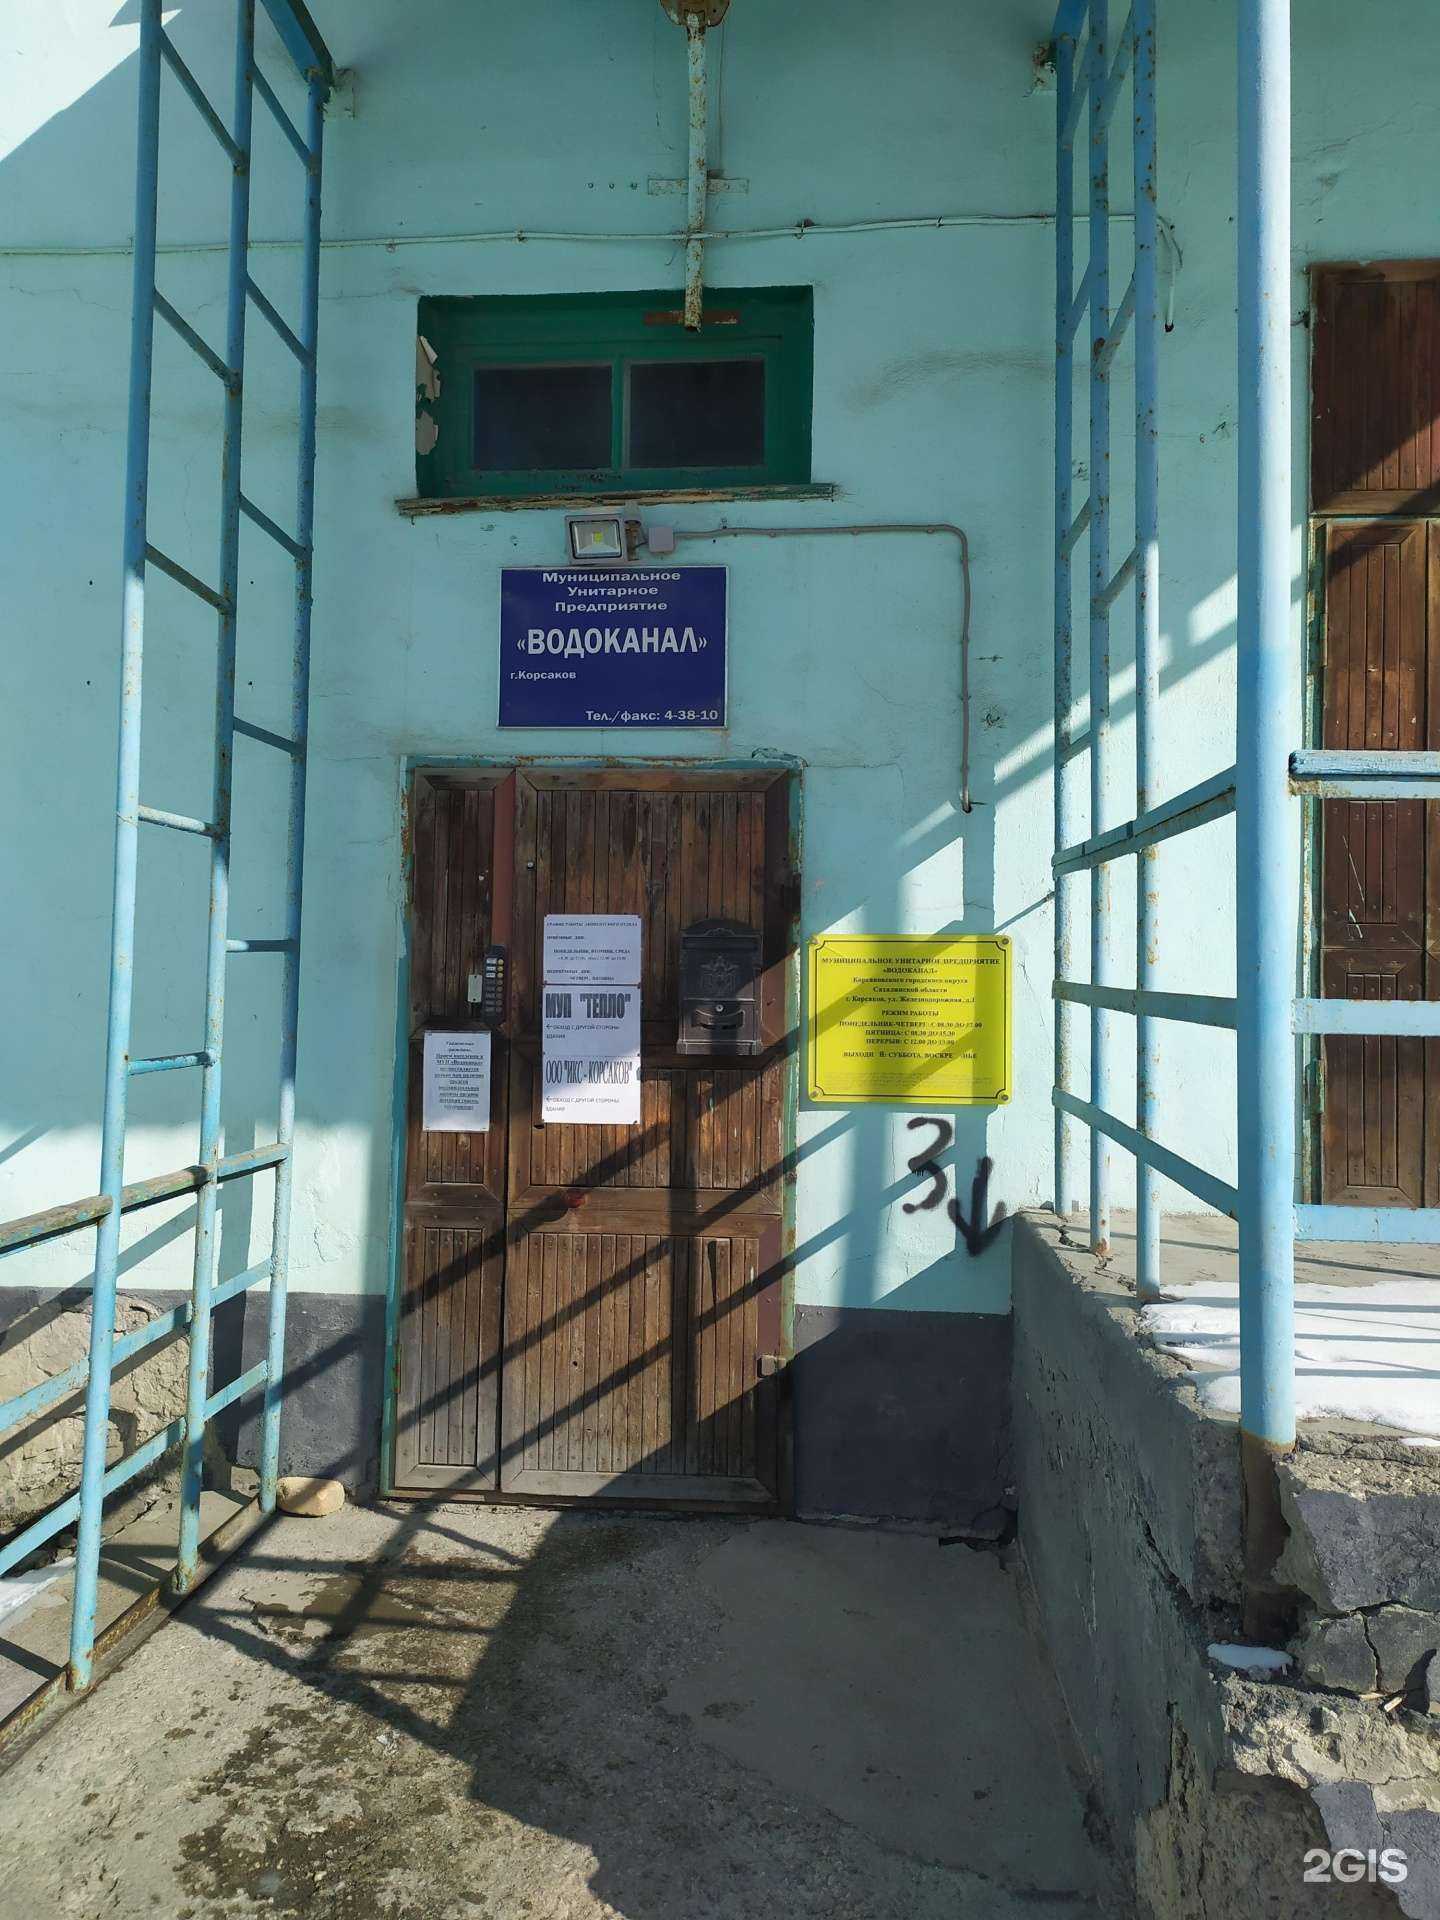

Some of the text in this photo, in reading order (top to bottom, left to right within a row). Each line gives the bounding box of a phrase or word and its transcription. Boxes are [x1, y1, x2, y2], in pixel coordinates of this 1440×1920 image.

[542, 571, 681, 583] Муниципальное
[567, 586, 659, 598] Унитарное
[555, 601, 668, 613] Предприятие
[516, 627, 708, 659] «ВОДОКАНАЛ»
[510, 670, 577, 681] г.Корсаков
[585, 710, 719, 723] Тел./факс: 4-38-10
[822, 957, 893, 965] МУНИЦИПАЛЬНОЕ
[895, 957, 940, 965] УНИТАРНОЕ
[545, 992, 632, 1019] МУП "ТЕПЛО"
[881, 1009, 909, 1017] РЕЖИМ
[545, 1060, 563, 1084] ООО
